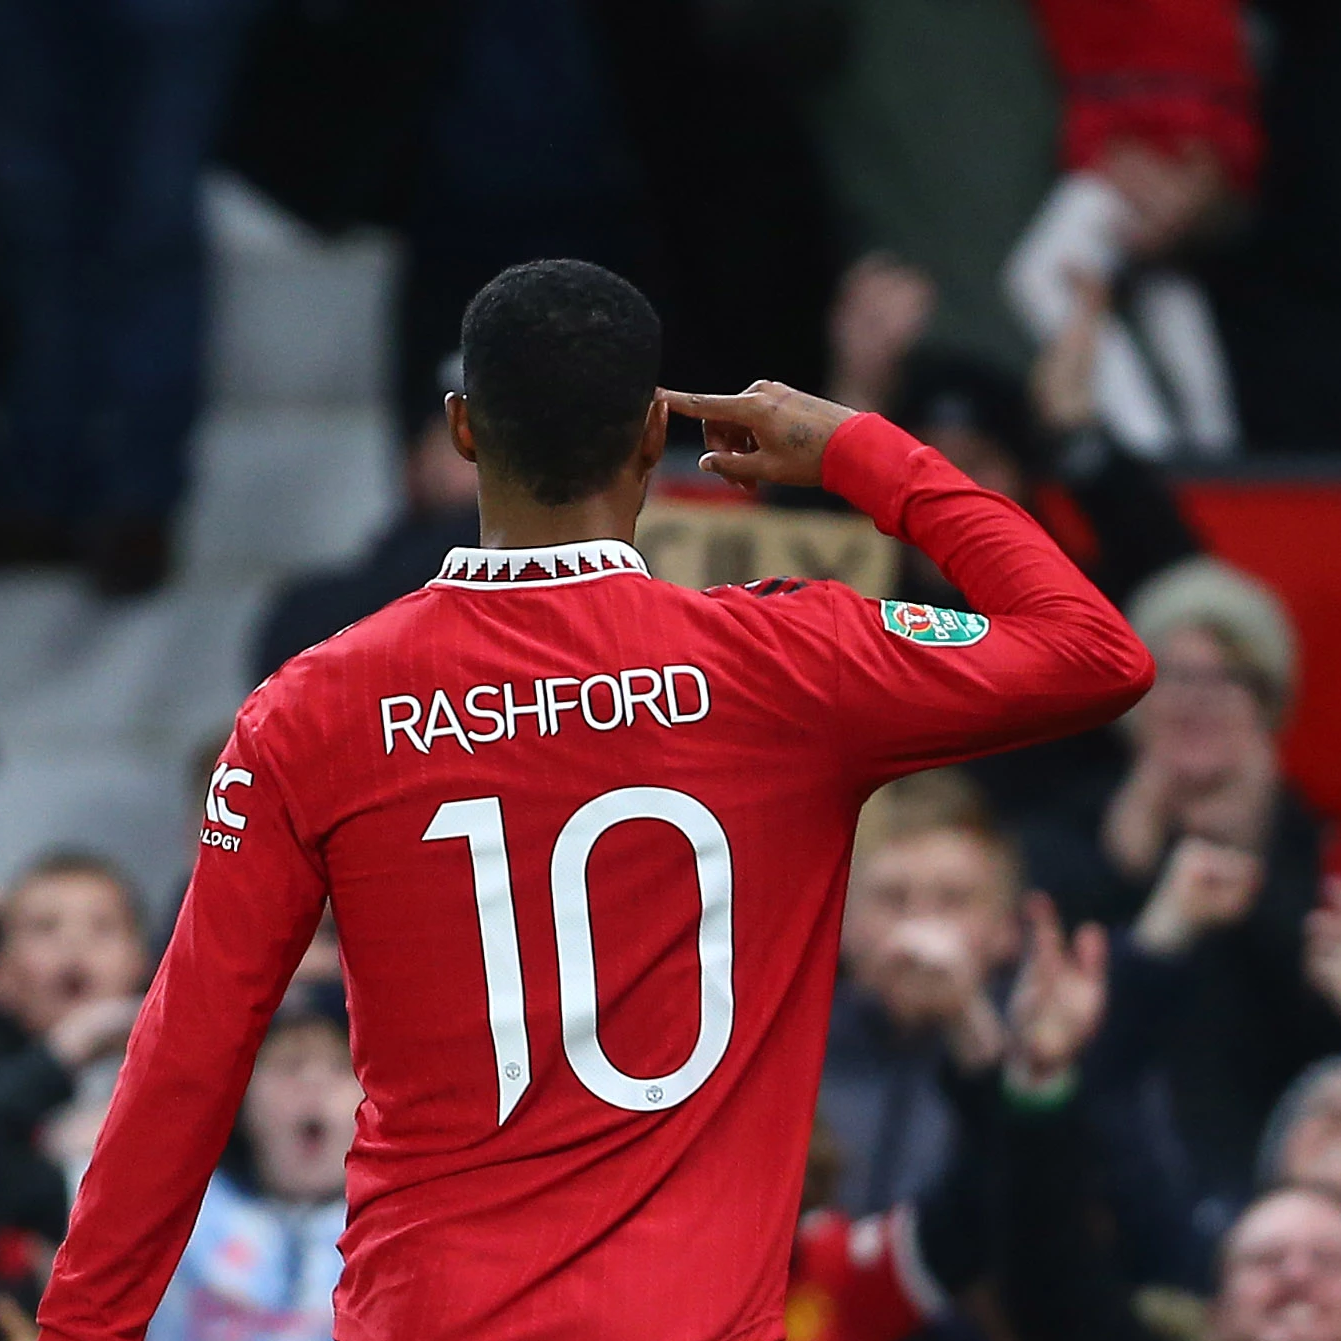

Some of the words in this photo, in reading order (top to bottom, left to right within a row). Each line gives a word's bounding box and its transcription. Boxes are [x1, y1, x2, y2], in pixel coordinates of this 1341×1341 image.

[380, 664, 711, 756] RASHFORD
[199, 827, 242, 853] LOGY
[420, 785, 735, 1128] 10
